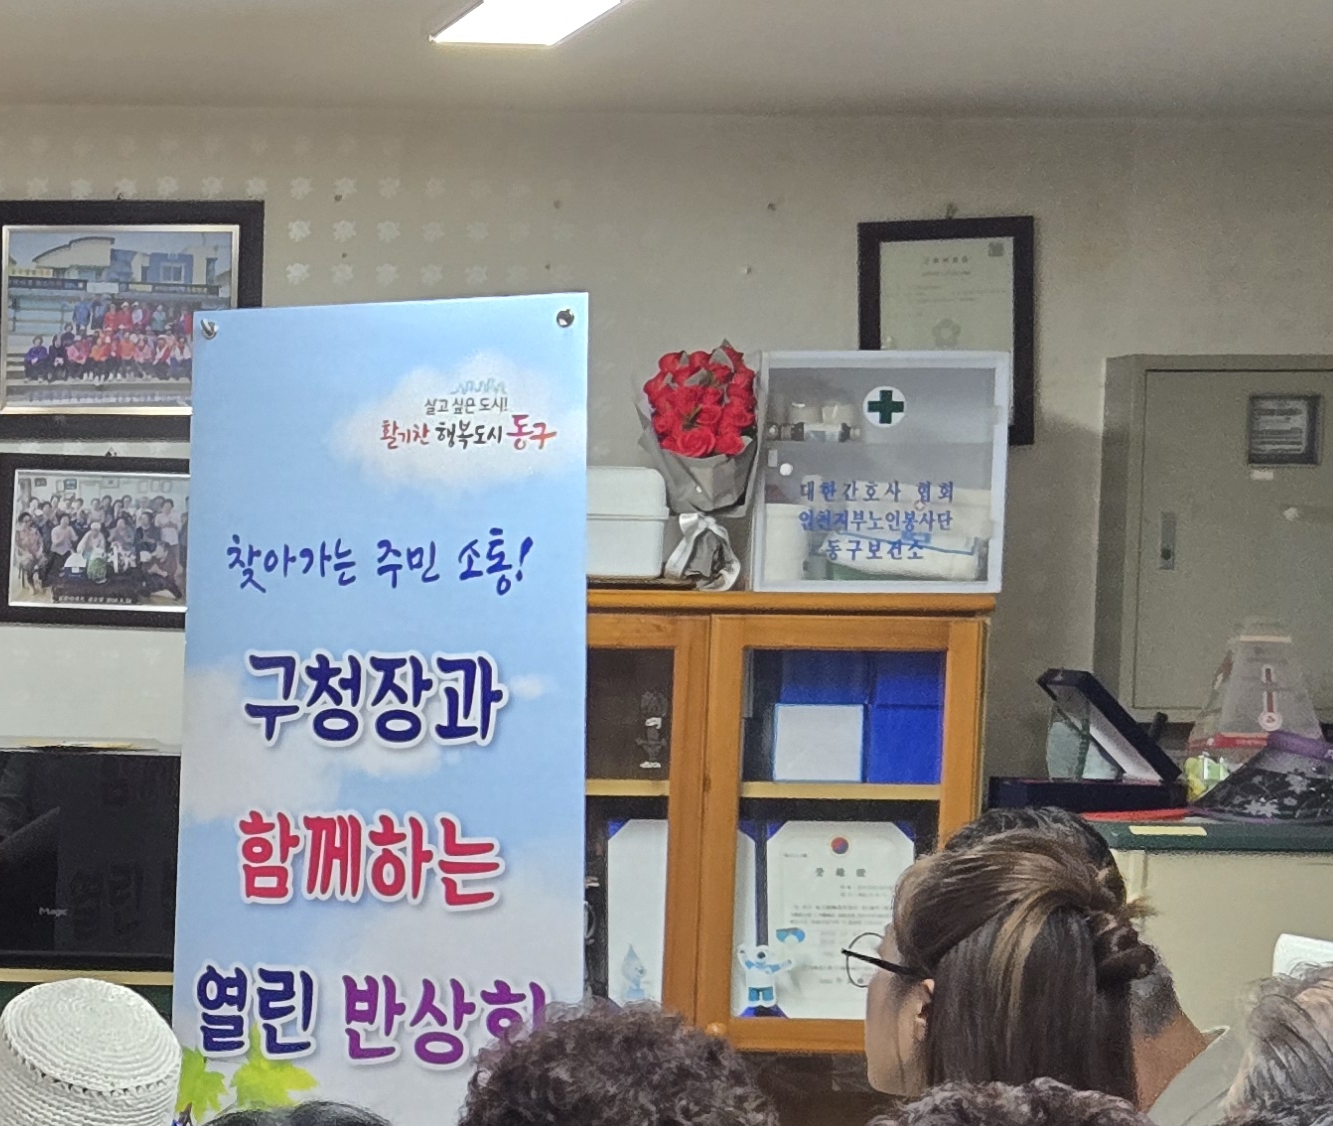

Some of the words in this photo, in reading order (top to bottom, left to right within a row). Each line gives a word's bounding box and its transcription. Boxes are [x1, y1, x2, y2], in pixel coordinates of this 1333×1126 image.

[424, 398, 449, 415] 살고
[452, 398, 476, 415] 싶은
[479, 397, 508, 413] 도시!
[381, 420, 430, 450] 활기찬
[435, 420, 502, 450] 행복도시
[507, 414, 558, 450] 동구
[800, 480, 901, 503] 대한간호사
[917, 480, 954, 503] 협회
[228, 534, 357, 594] 찾아가는
[377, 539, 440, 588] 주민
[458, 528, 534, 595] 소통!
[827, 539, 924, 561] 동구보건소
[245, 654, 503, 743] 구청장과
[239, 810, 501, 906] 함께하는
[197, 965, 314, 1054] 열린
